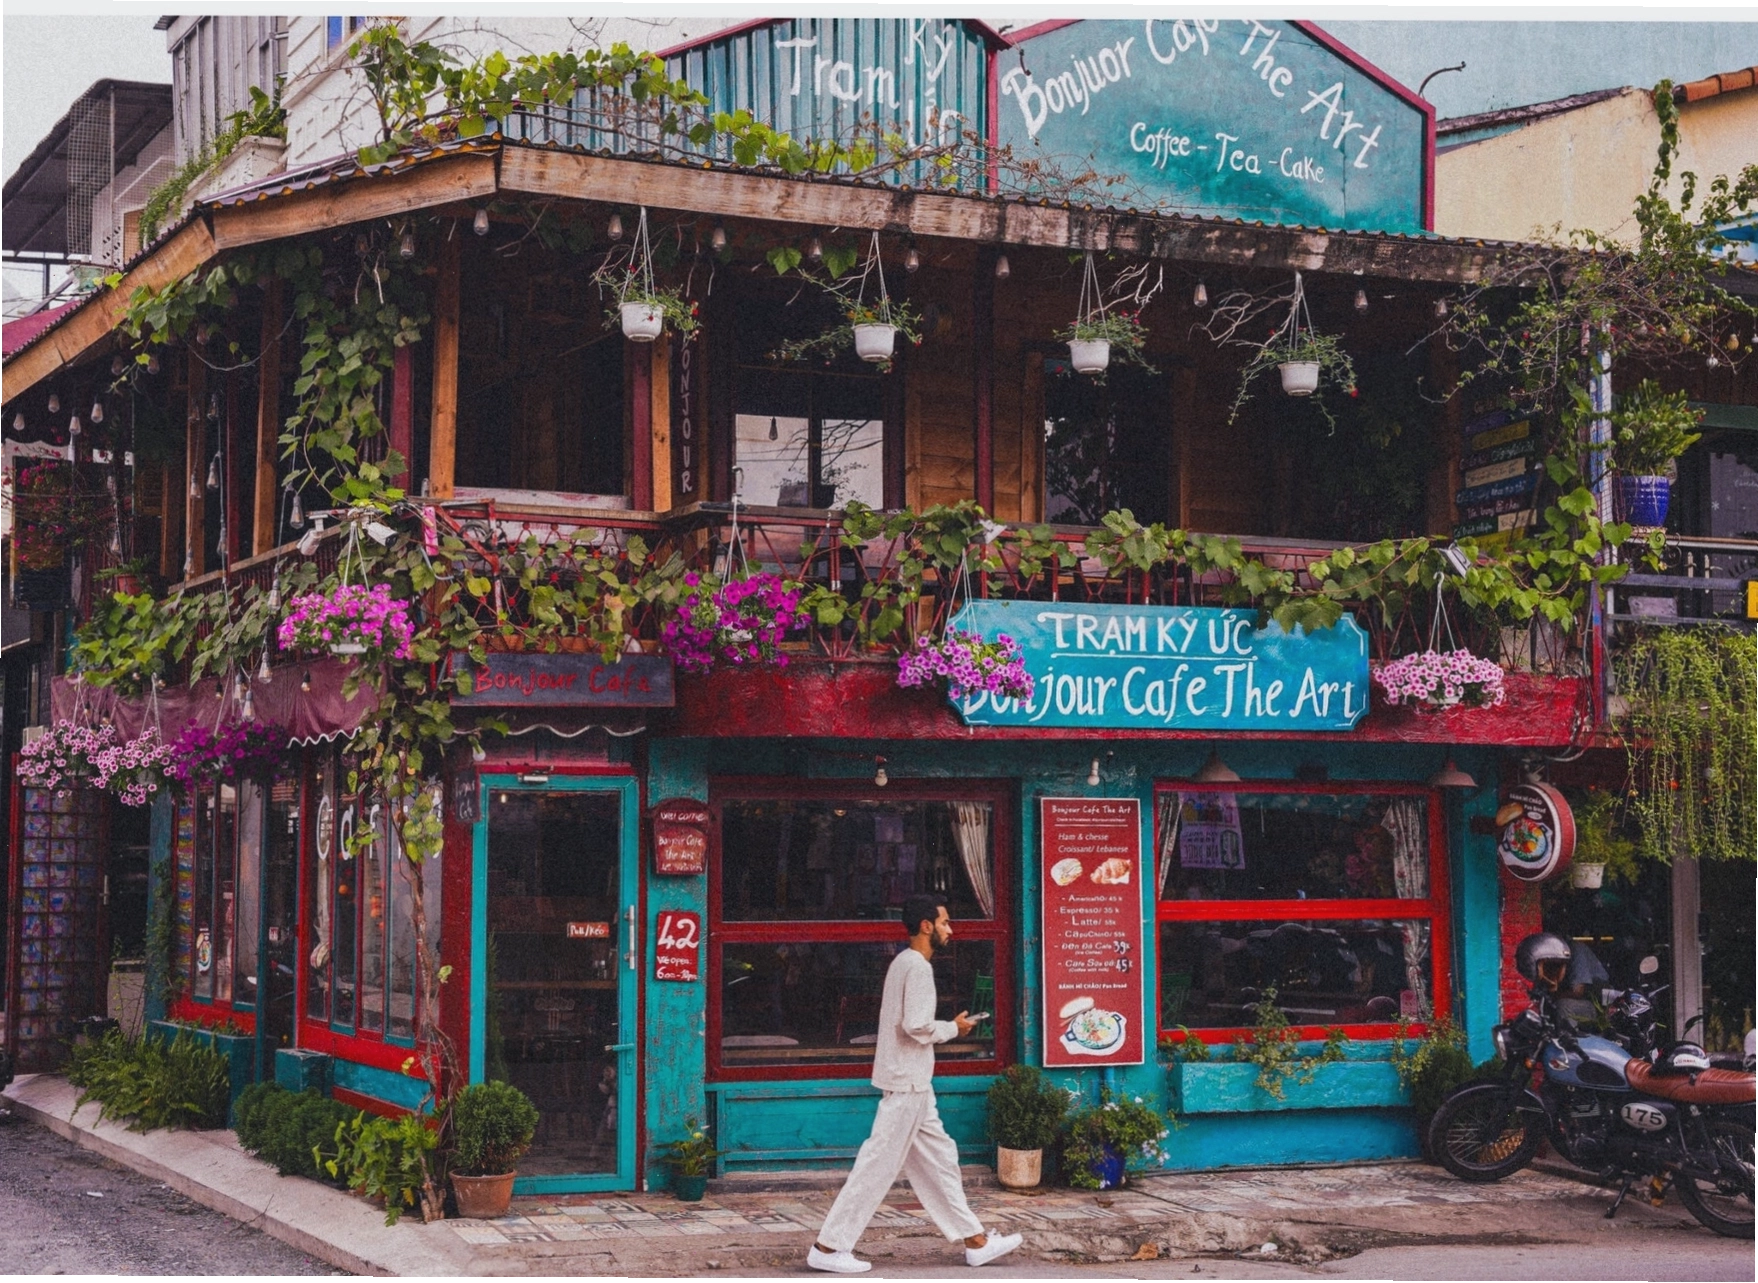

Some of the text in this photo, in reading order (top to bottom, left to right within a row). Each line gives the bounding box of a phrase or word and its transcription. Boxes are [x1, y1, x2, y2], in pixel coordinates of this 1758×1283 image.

[1001, 37, 1134, 139] Bonjuor
[1241, 18, 1293, 98] The
[1301, 82, 1382, 168] Art
[1130, 122, 1191, 169] Coffee
[1215, 132, 1262, 174] Tea
[1037, 609, 1253, 655] TRẠM KÝ ỨC
[475, 665, 578, 696] Bonjour
[1122, 664, 1208, 723] Cafe
[1213, 661, 1284, 718] The
[1290, 666, 1355, 719] Art
[1051, 805, 1132, 815] Bonjour Cafe The Art
[658, 915, 699, 950] 42
[1625, 1106, 1663, 1126] 175
